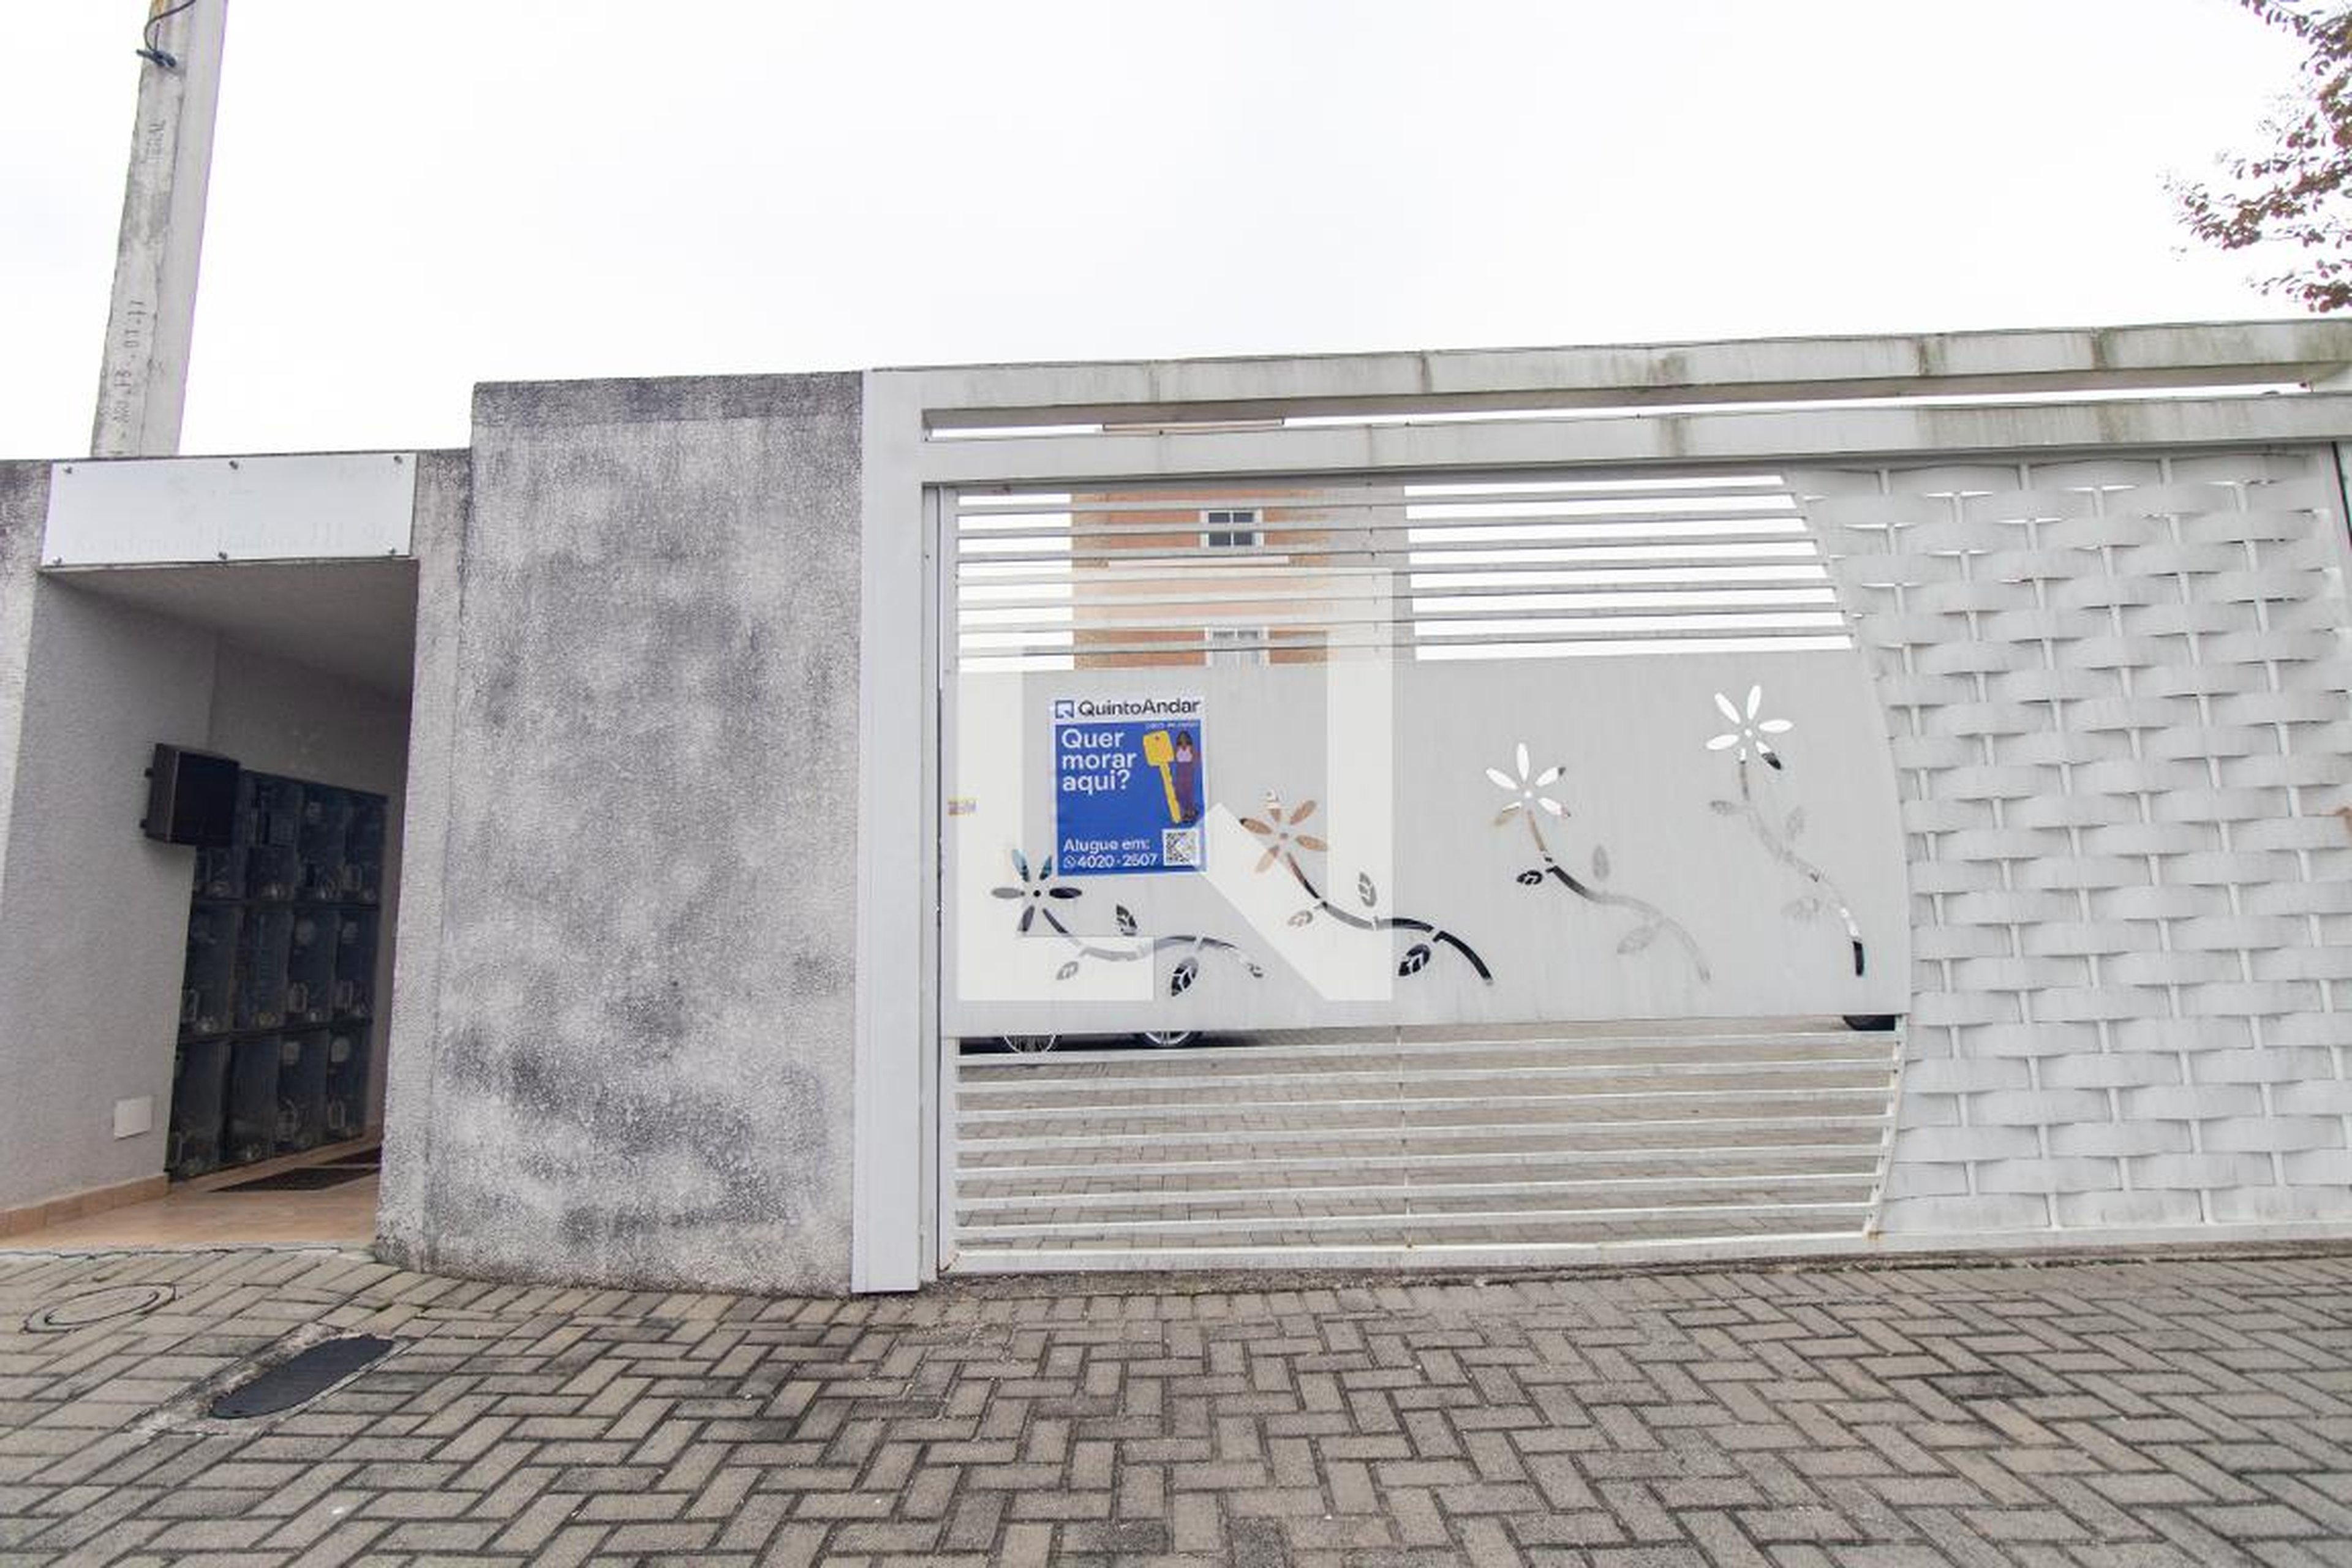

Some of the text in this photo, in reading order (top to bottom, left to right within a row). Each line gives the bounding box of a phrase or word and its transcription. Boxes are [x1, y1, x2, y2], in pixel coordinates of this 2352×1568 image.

[1078, 698, 1200, 717] QuintoAndar
[1061, 728, 1125, 748] Quer
[1062, 753, 1137, 770] morar
[1063, 769, 1131, 795] aqui?
[1063, 838, 1151, 854] Alugue em:
